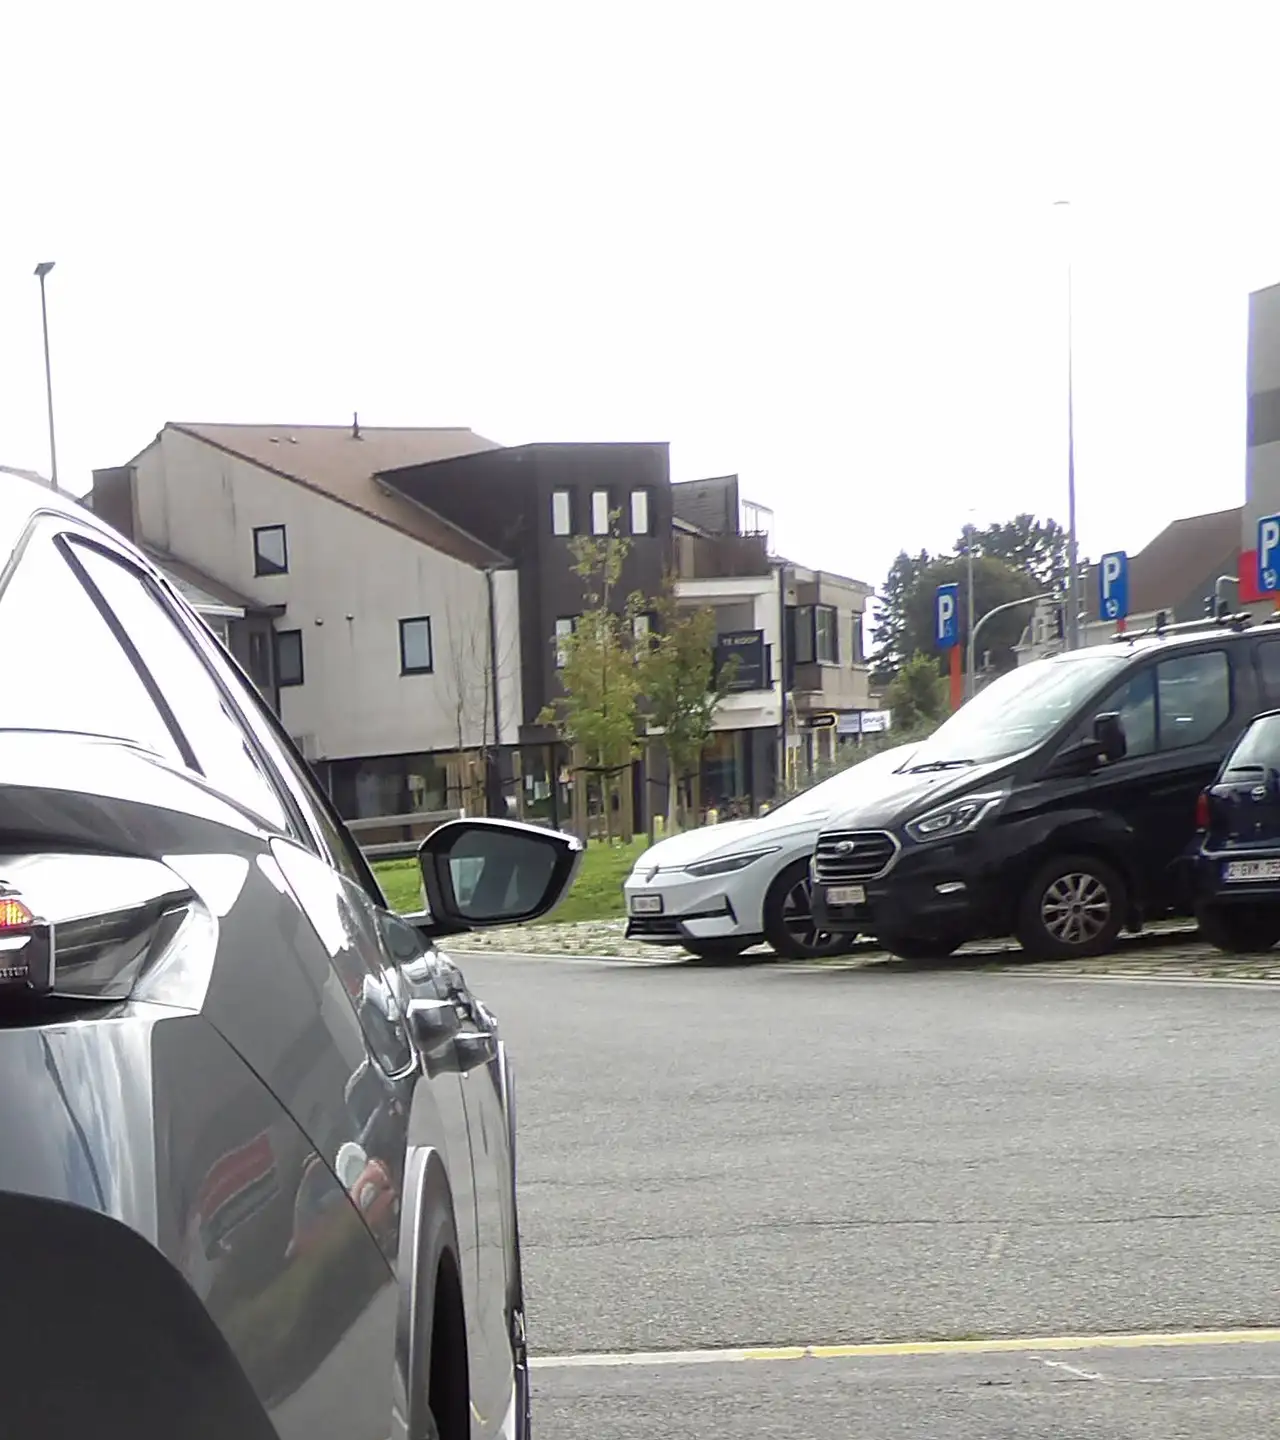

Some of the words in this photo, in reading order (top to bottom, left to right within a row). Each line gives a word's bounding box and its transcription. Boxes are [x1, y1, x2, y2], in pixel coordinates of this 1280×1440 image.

[1261, 521, 1280, 569] P
[1103, 556, 1121, 600] P
[938, 594, 954, 639] P
